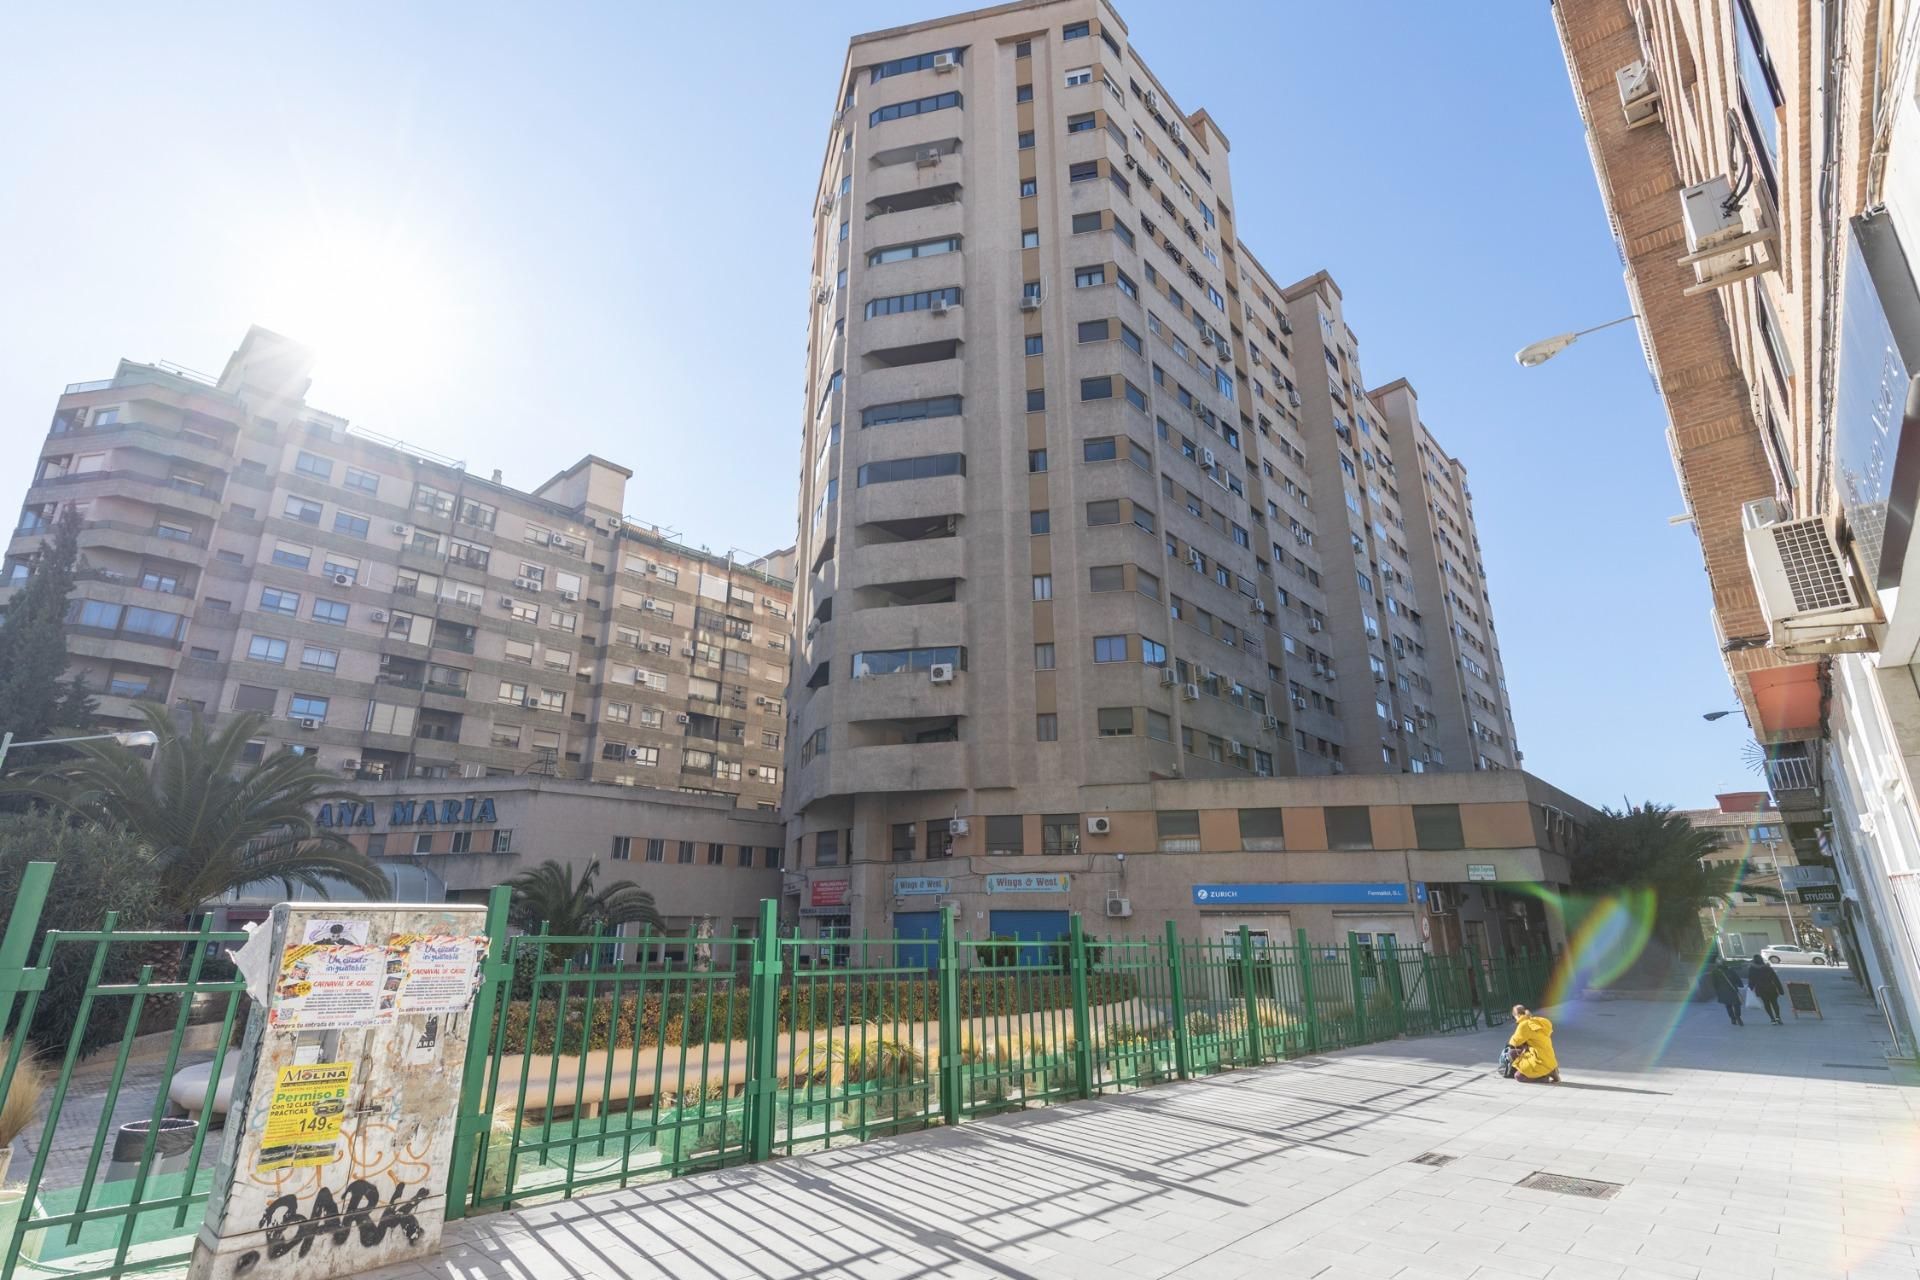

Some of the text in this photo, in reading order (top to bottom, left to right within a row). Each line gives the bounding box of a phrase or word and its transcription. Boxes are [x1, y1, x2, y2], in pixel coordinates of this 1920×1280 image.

[316, 797, 498, 828] ANA MARIA
[900, 880, 917, 889] Wings
[996, 877, 1022, 888] Wings
[1026, 877, 1033, 887] &
[1210, 890, 1238, 898] ZURICH
[425, 944, 436, 953] Un
[328, 954, 340, 964] Un
[276, 1088, 345, 1103] Permiso B
